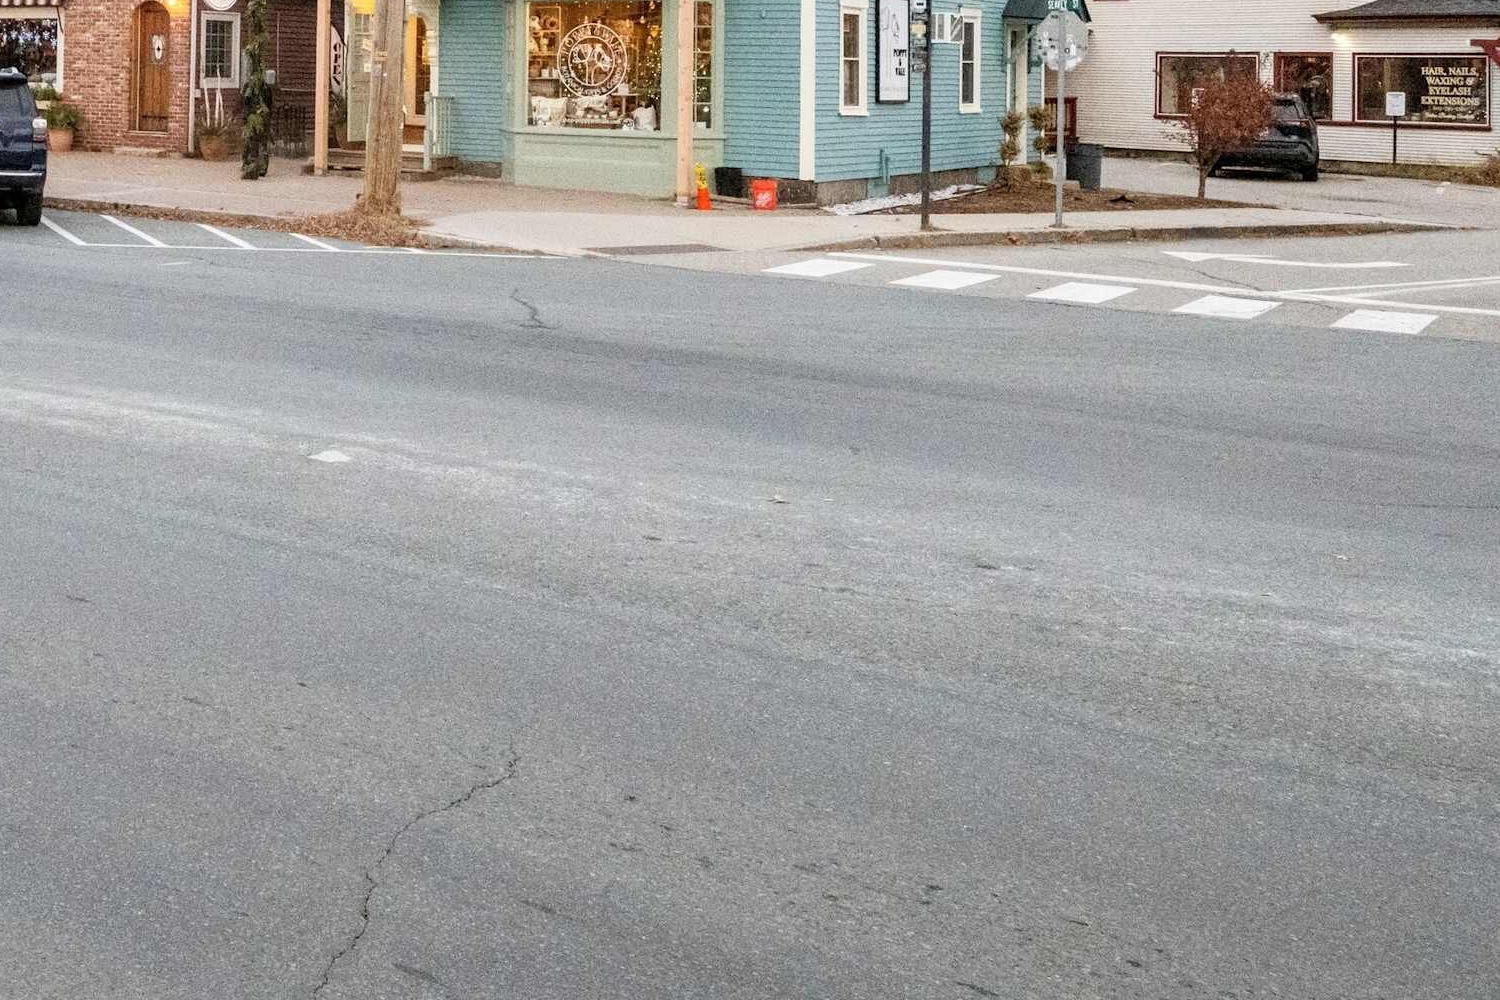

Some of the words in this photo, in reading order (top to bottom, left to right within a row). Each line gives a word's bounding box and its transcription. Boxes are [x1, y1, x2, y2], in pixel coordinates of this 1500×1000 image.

[1048, 0, 1068, 10] SEAVEY
[1072, 0, 1079, 9] ST
[1421, 67, 1447, 76] HAIR,
[1448, 67, 1479, 76] NAILS,
[1426, 77, 1464, 86] WAXING
[1465, 77, 1476, 86] &
[1428, 87, 1472, 95] EYELASH
[1421, 96, 1480, 106] EXTENSIONS
